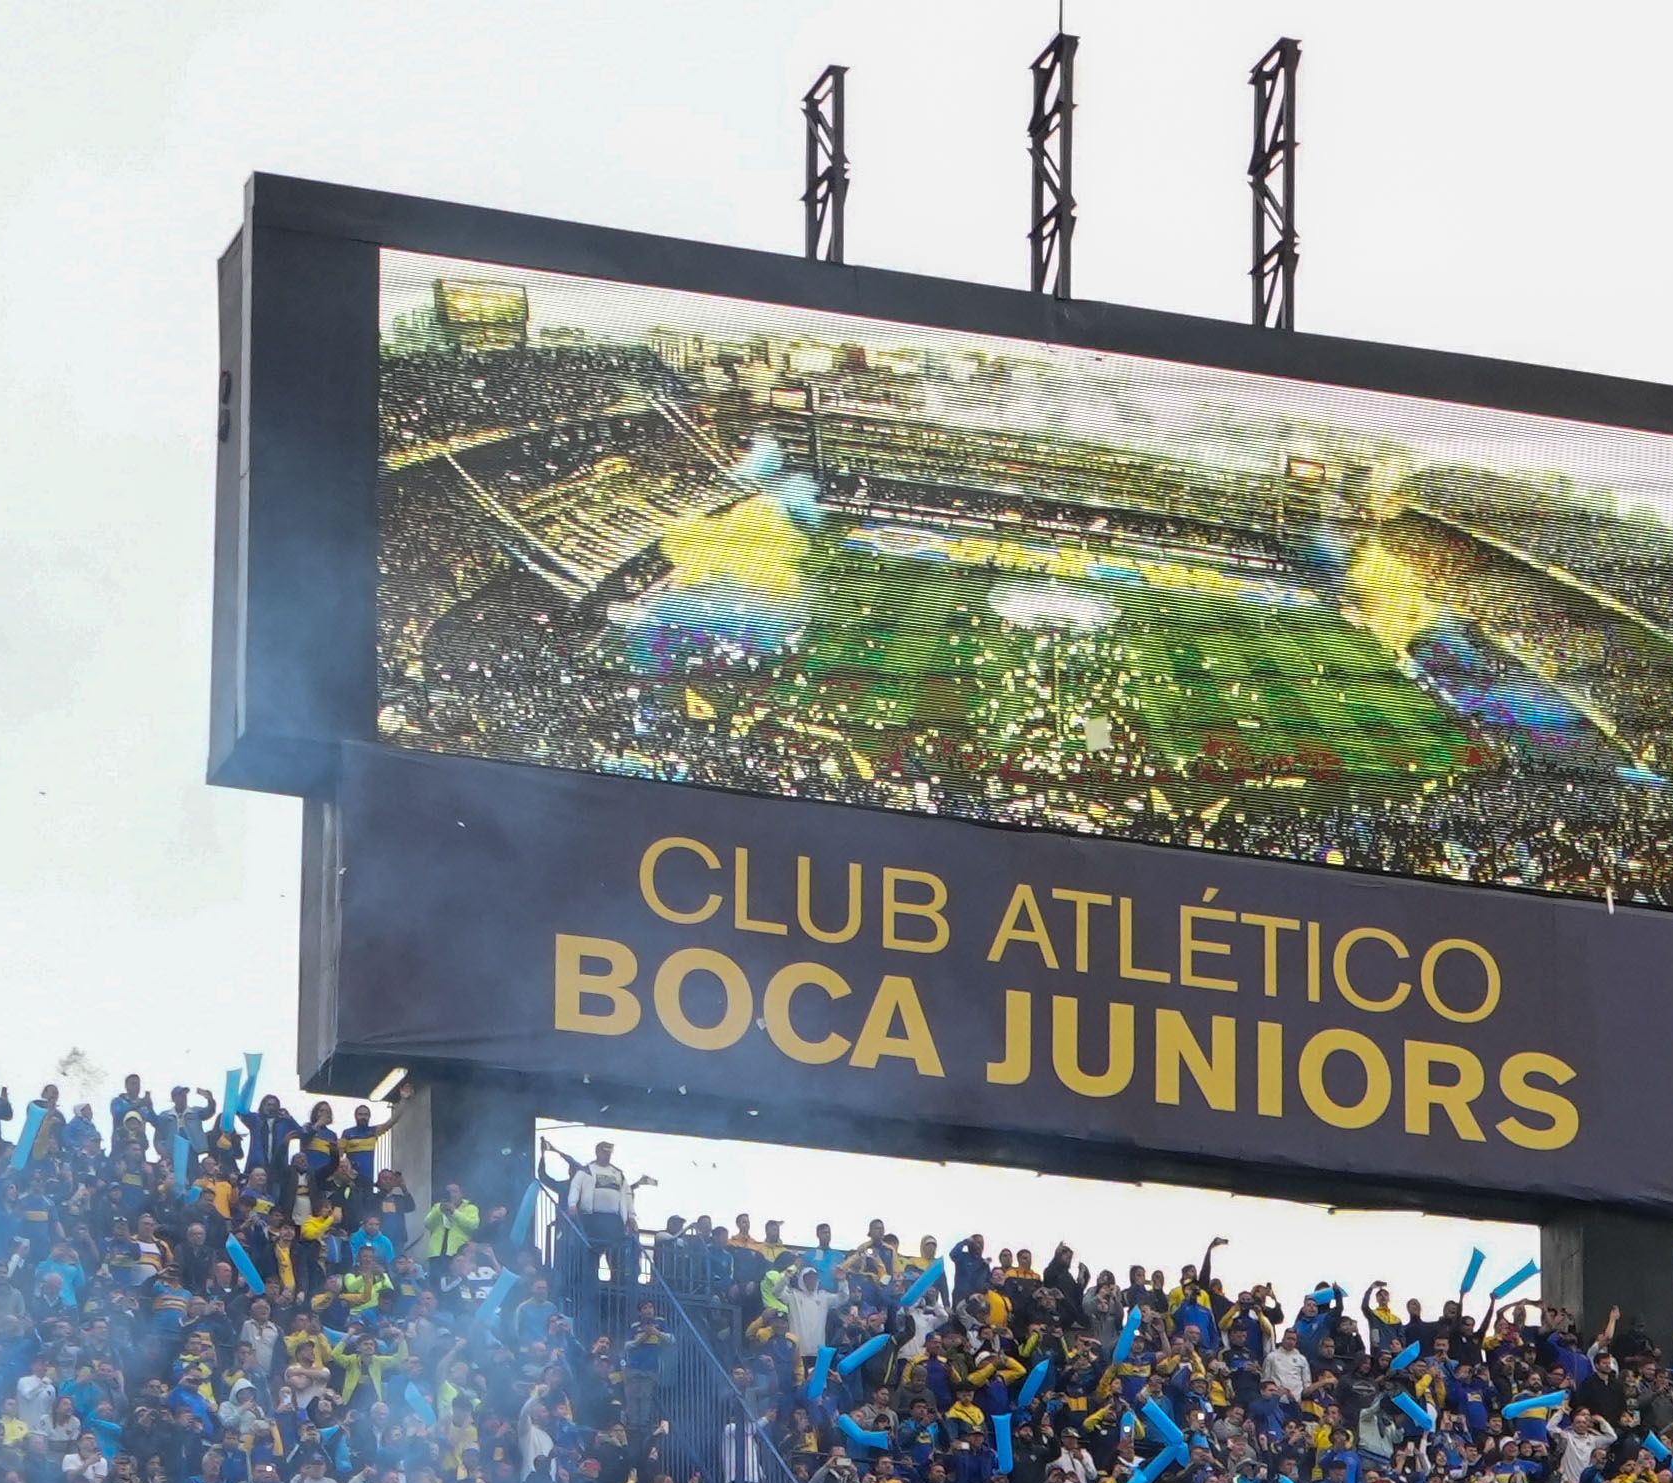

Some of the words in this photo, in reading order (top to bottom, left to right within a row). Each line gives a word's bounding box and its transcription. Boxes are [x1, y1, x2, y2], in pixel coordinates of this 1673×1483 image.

[638, 835, 951, 954] CLUB
[987, 882, 1503, 1025] ATLÉTICO
[555, 933, 945, 1078] BOCA
[986, 988, 1581, 1152] JUNIORS
